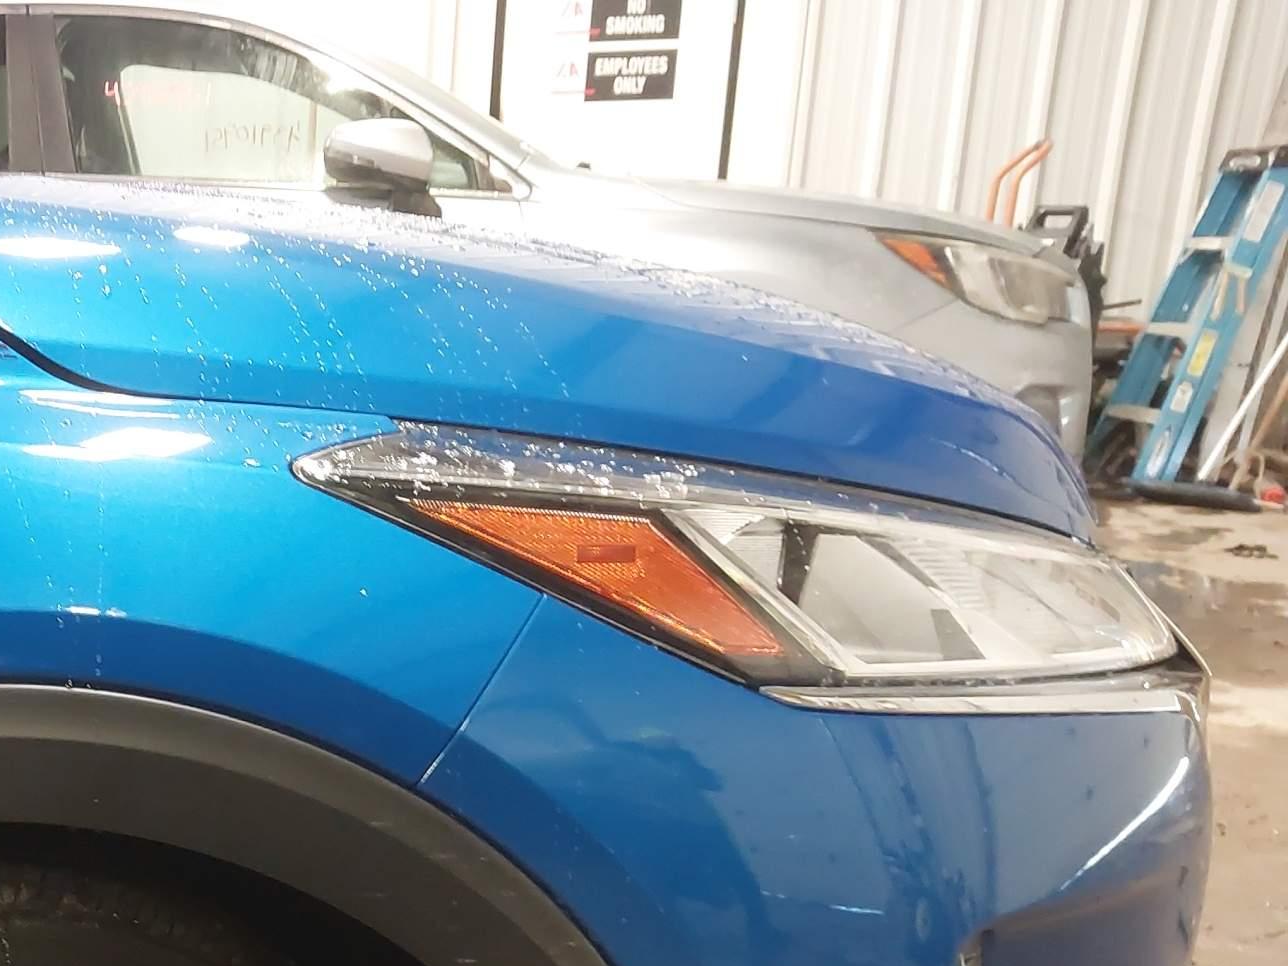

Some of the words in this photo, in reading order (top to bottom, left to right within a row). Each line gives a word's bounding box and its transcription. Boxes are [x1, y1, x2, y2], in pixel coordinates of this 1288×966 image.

[627, 0, 647, 14] NO
[605, 14, 665, 35] SMOKING
[594, 56, 669, 76] EMPLOYEES
[613, 76, 648, 95] ONLY
